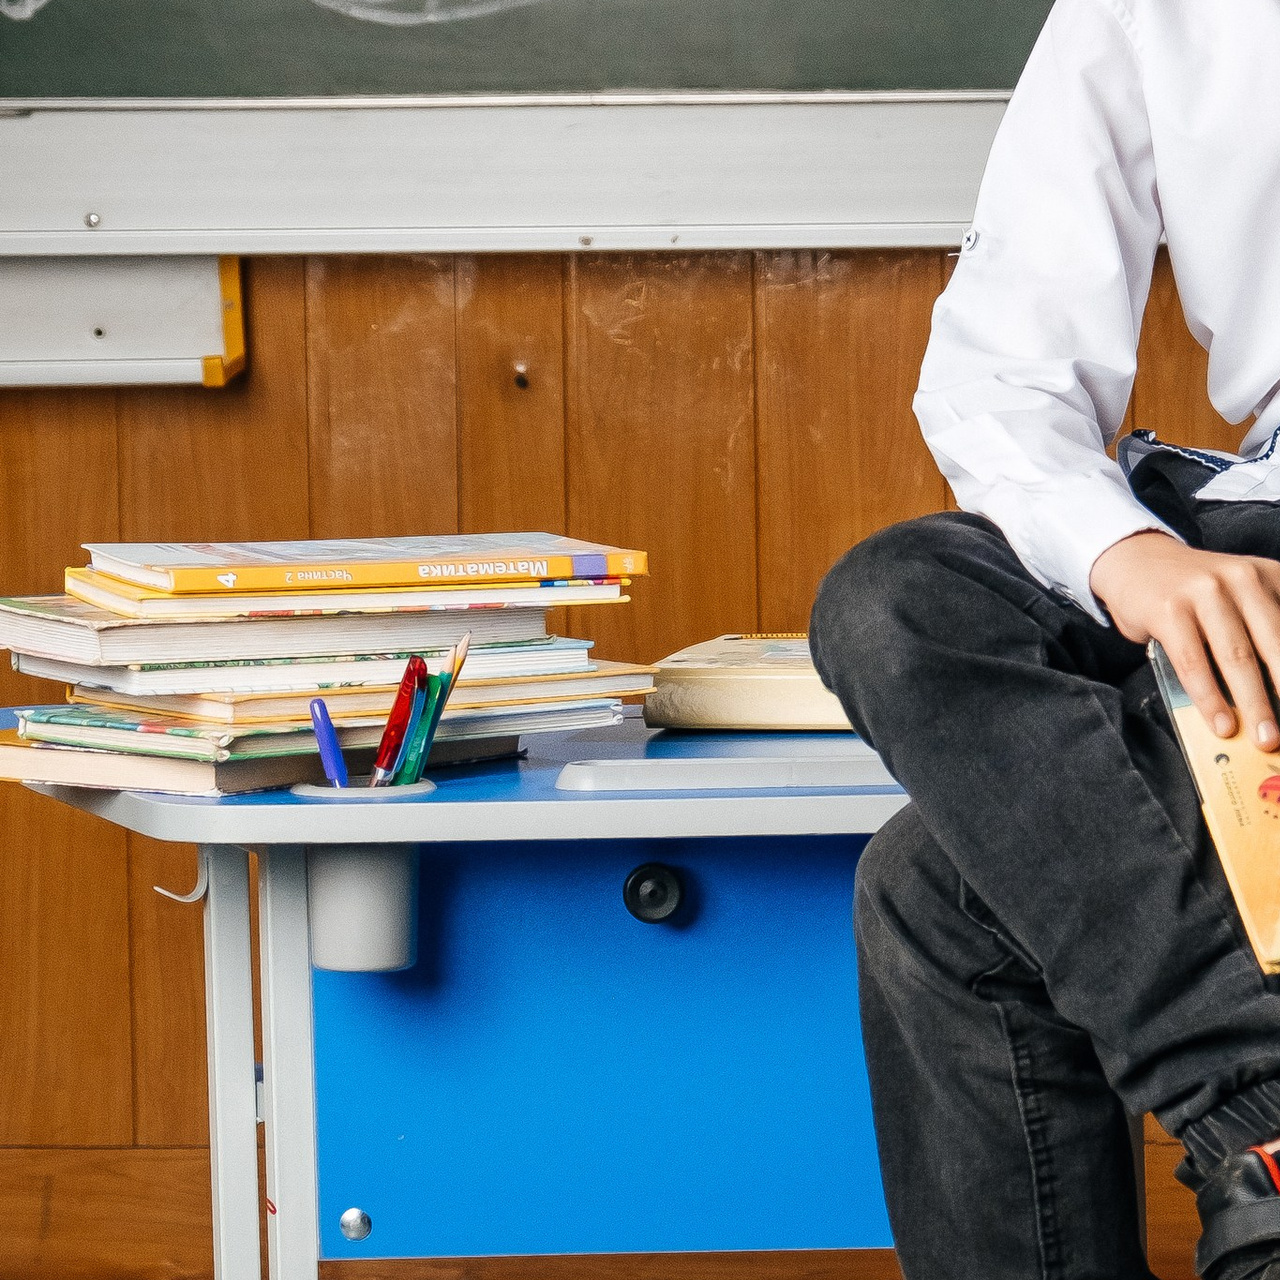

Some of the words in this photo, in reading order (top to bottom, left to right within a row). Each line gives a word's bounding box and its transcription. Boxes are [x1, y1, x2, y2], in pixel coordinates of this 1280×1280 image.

[297, 568, 354, 584] Частина
[417, 558, 548, 579] Математика
[216, 572, 238, 589] 4
[285, 571, 293, 583] 2
